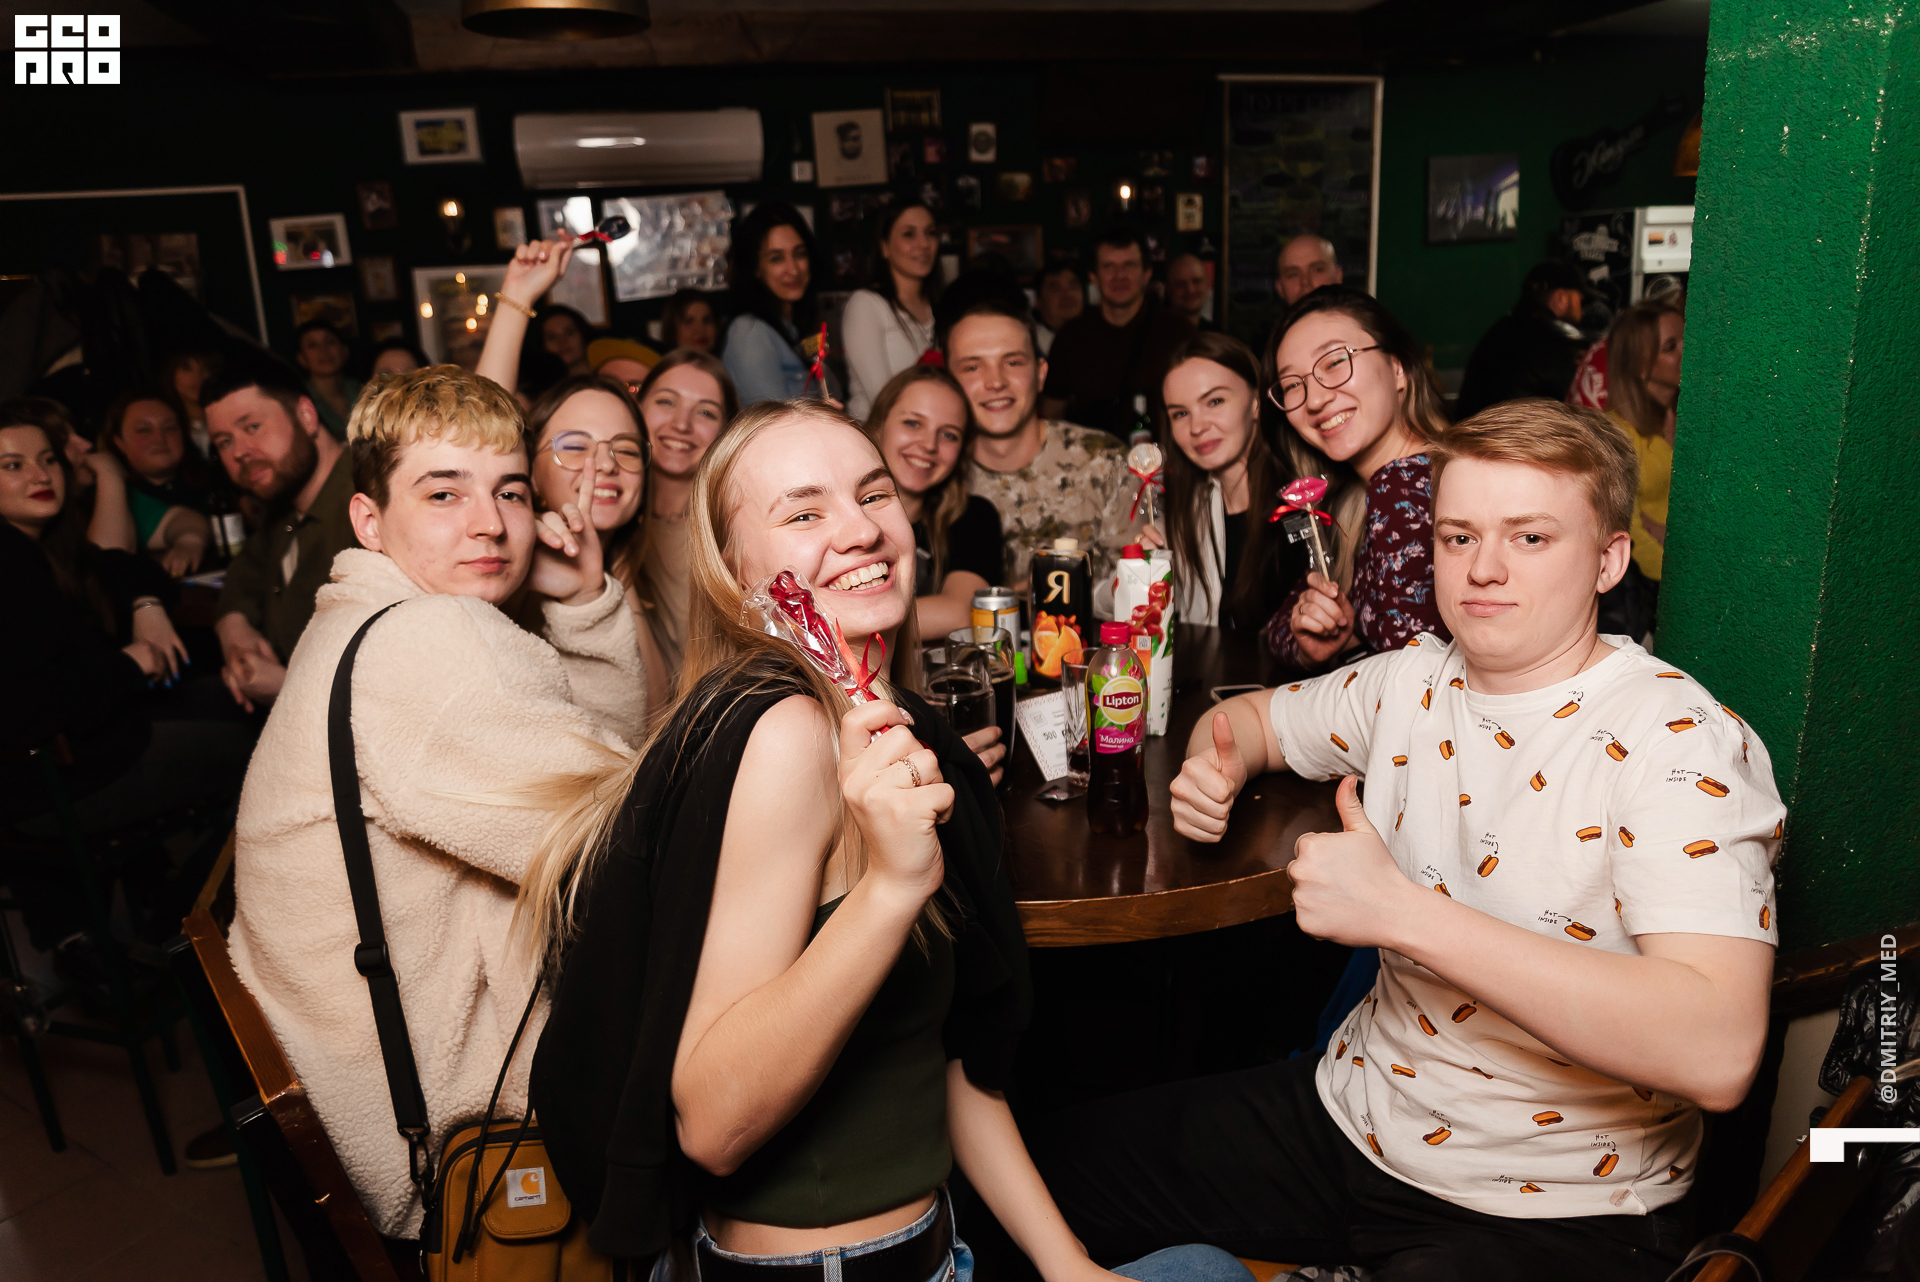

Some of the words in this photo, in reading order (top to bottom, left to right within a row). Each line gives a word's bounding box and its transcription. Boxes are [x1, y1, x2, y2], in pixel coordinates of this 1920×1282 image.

[1043, 570, 1070, 605] Я
[1106, 695, 1139, 707] Lipton
[1100, 735, 1135, 744] Малина
[1671, 768, 1686, 776] HOT
[1543, 909, 1558, 917] HOT
[1538, 916, 1558, 924] INSIDE
